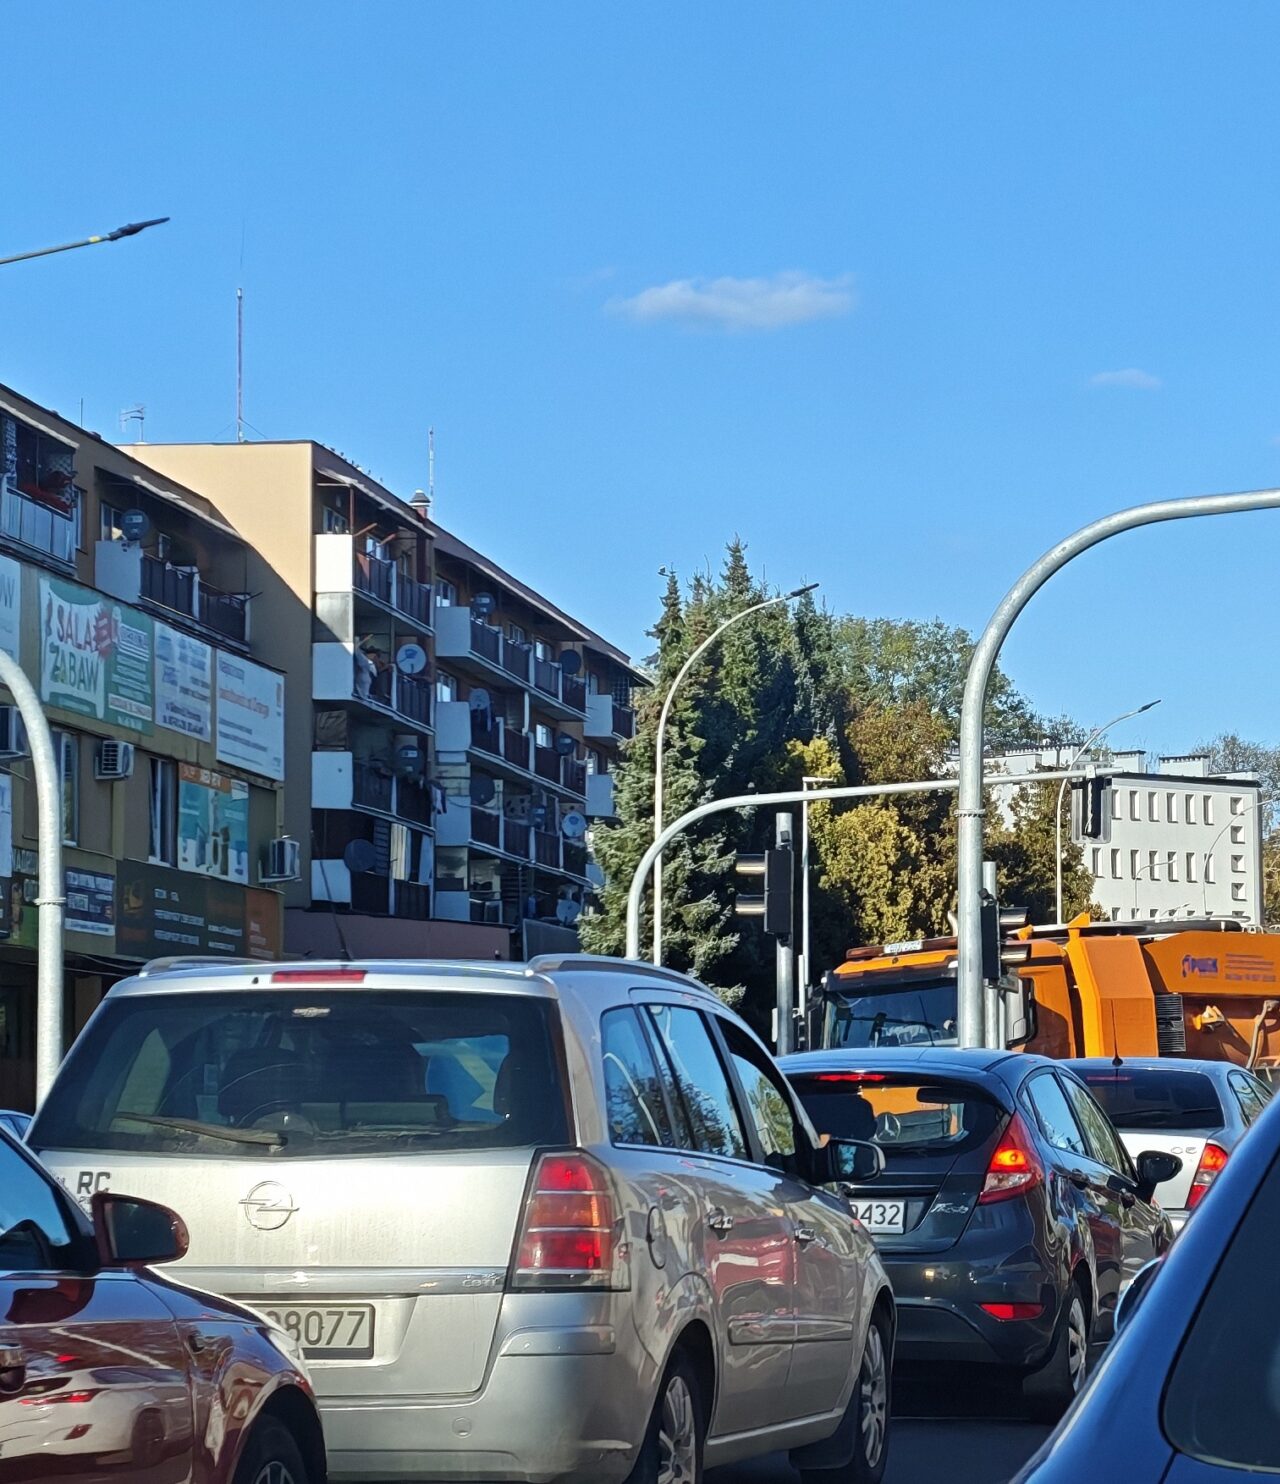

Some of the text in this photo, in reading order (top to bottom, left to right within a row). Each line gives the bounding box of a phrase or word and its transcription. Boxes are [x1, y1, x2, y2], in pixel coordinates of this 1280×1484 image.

[57, 604, 97, 652] SALA
[49, 642, 99, 694] ZABAW
[77, 1170, 111, 1194] RC
